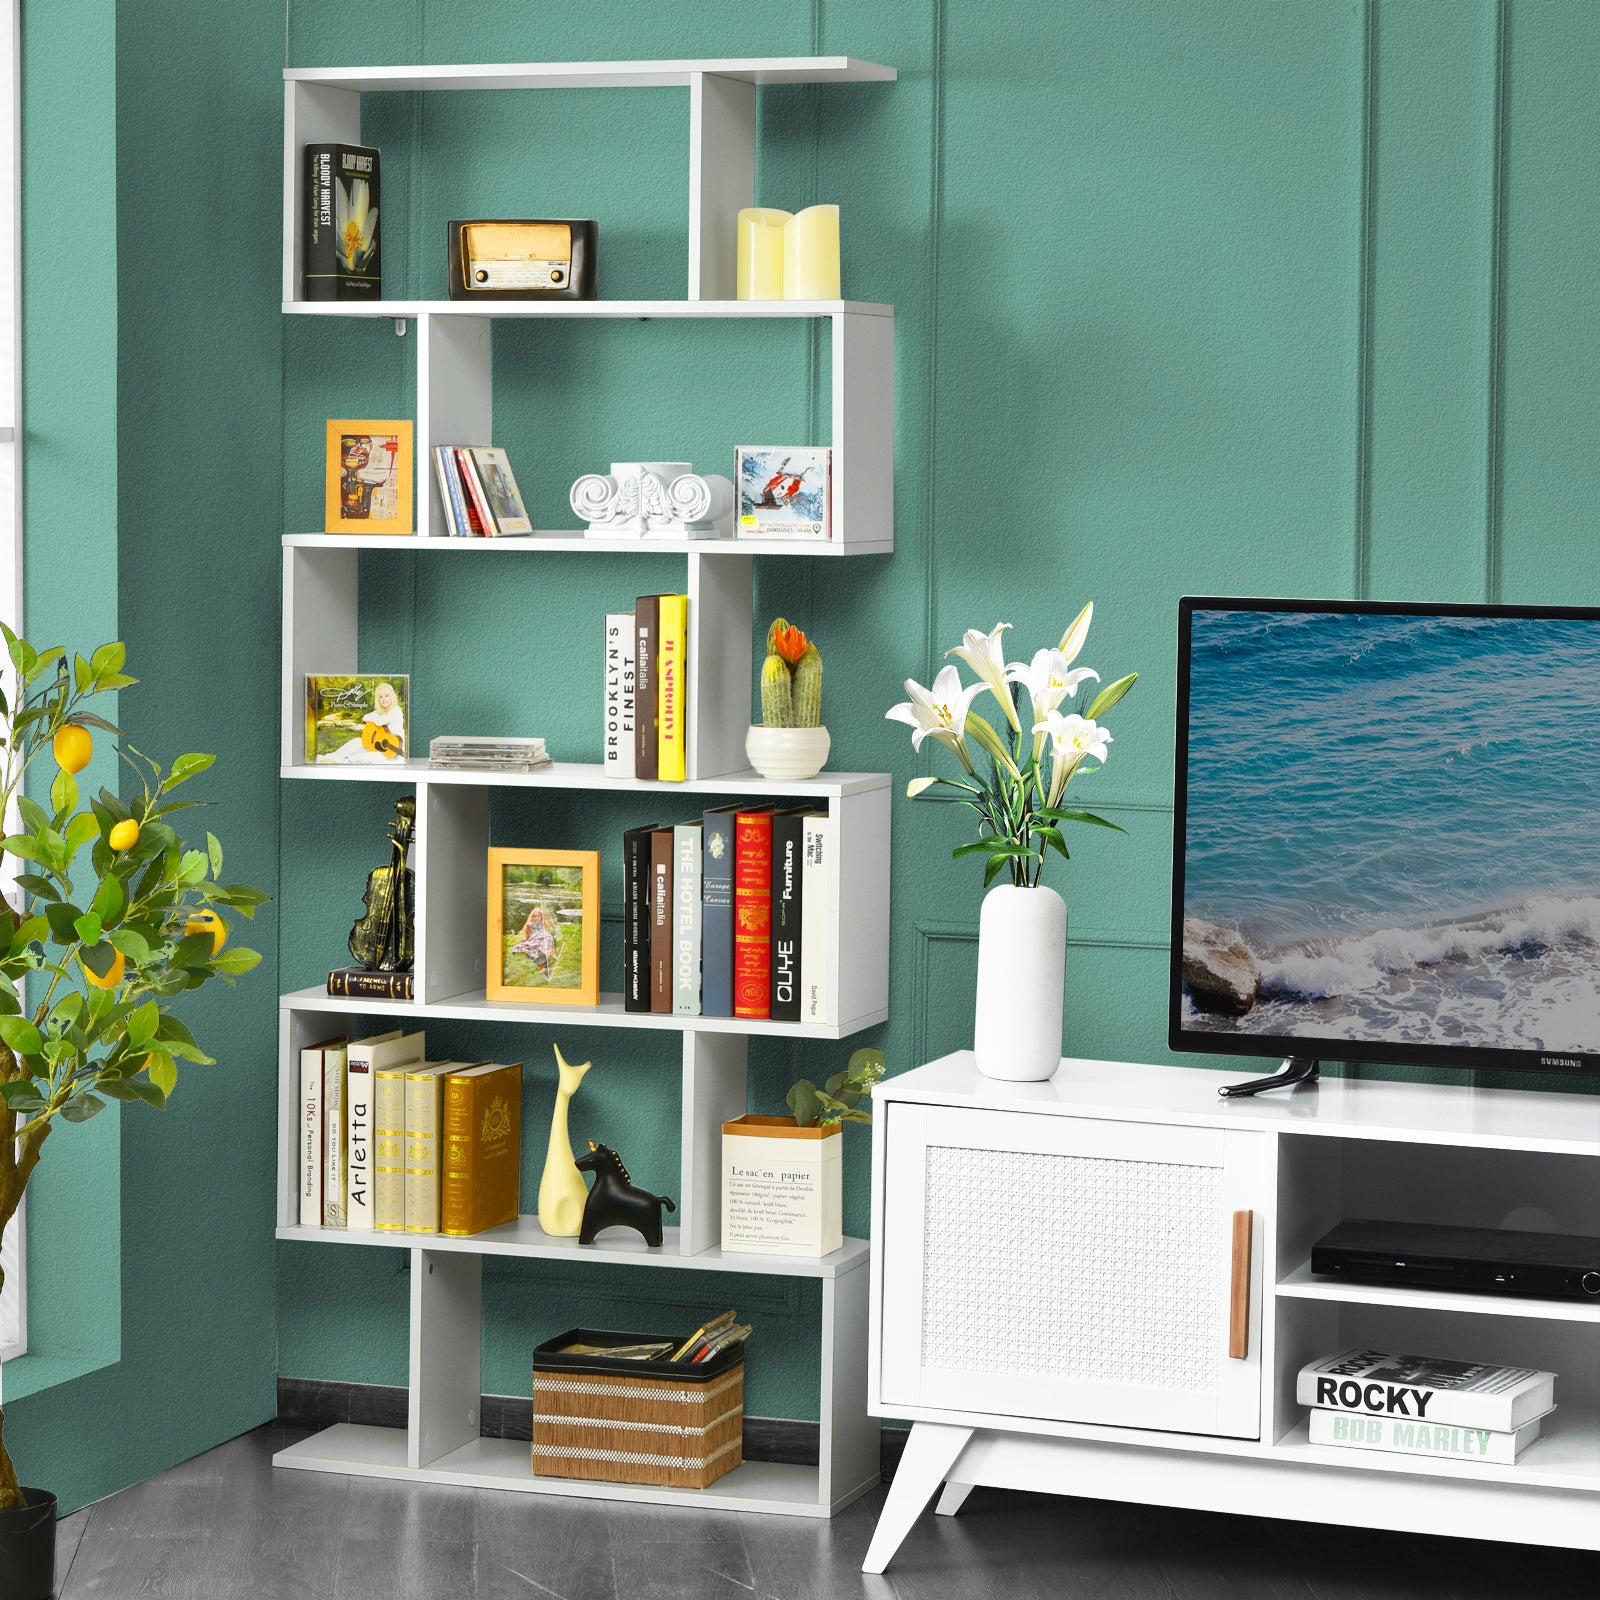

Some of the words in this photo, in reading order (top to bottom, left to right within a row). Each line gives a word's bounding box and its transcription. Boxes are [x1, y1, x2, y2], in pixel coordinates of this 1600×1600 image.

[320, 153, 331, 187] BLOODY
[320, 188, 331, 227] HARVEST
[639, 639, 649, 690] caliaitalia
[352, 701, 369, 710] Simple
[607, 626, 619, 761] BROOKLYN'S
[623, 657, 635, 732] FINEST
[680, 837, 694, 873] THE
[807, 844, 815, 858] Mac
[814, 833, 824, 865] Switching
[704, 880, 731, 891] Europe
[782, 840, 793, 900] Furniture
[656, 876, 666, 926] caliaitalia
[679, 876, 694, 936] HOTEL
[360, 976, 387, 985] FAREWELL
[679, 940, 694, 991] BOOK
[777, 940, 793, 1002] OUYE
[369, 984, 386, 992] ARMS
[809, 1001, 818, 1017] Pogue
[1540, 1057, 1582, 1068] SAMSUNG
[306, 1097, 316, 1122] 10Ks
[331, 1122, 337, 1134] DO
[306, 1129, 315, 1163] Personal
[350, 1102, 367, 1207] Arletta
[305, 1165, 314, 1198] Branding
[331, 1173, 337, 1181] IT
[732, 1166, 744, 1176] Le
[781, 1171, 810, 1182] papier
[1327, 1350, 1390, 1376] ROCKY
[1316, 1375, 1434, 1418] ROCKY
[1333, 1416, 1383, 1444] BOB
[1393, 1422, 1492, 1456] MARLEY
